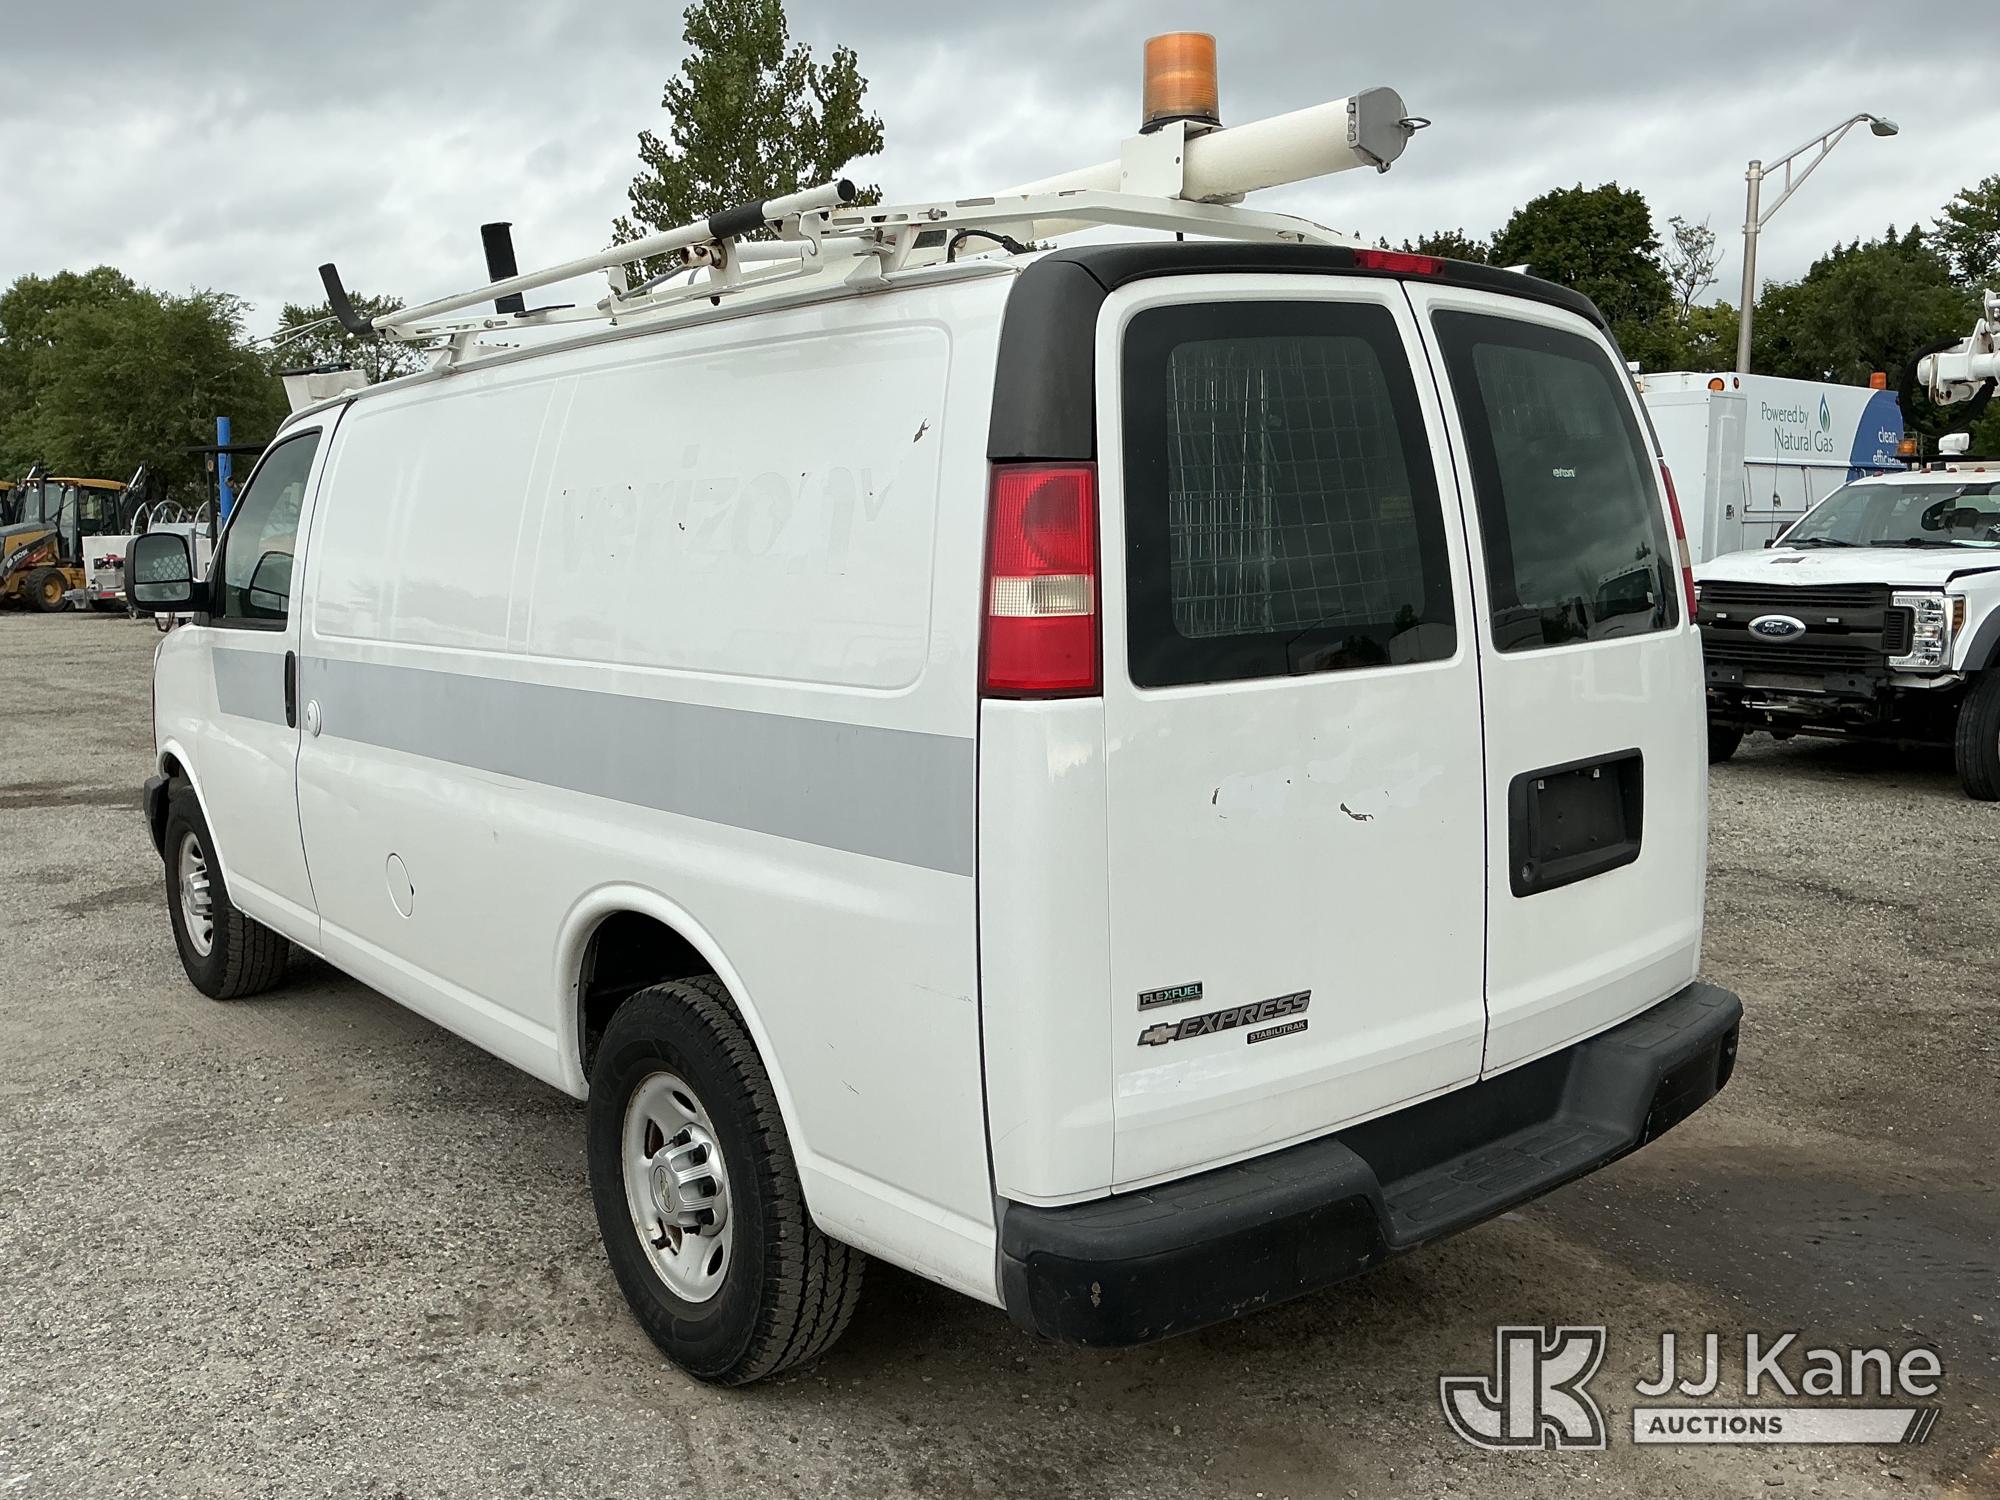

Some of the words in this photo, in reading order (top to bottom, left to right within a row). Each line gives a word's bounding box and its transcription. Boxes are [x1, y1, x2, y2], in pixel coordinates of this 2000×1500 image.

[1761, 401, 1798, 423] Powered
[1799, 404, 1809, 430] by
[1774, 426, 1812, 452] Natural
[1814, 430, 1834, 453] Gas
[1761, 621, 1790, 634] Ford
[1142, 985, 1201, 1005] FLEXFUEL
[1177, 991, 1311, 1040] EXPRESS
[1249, 1021, 1306, 1042] STABILITRAK
